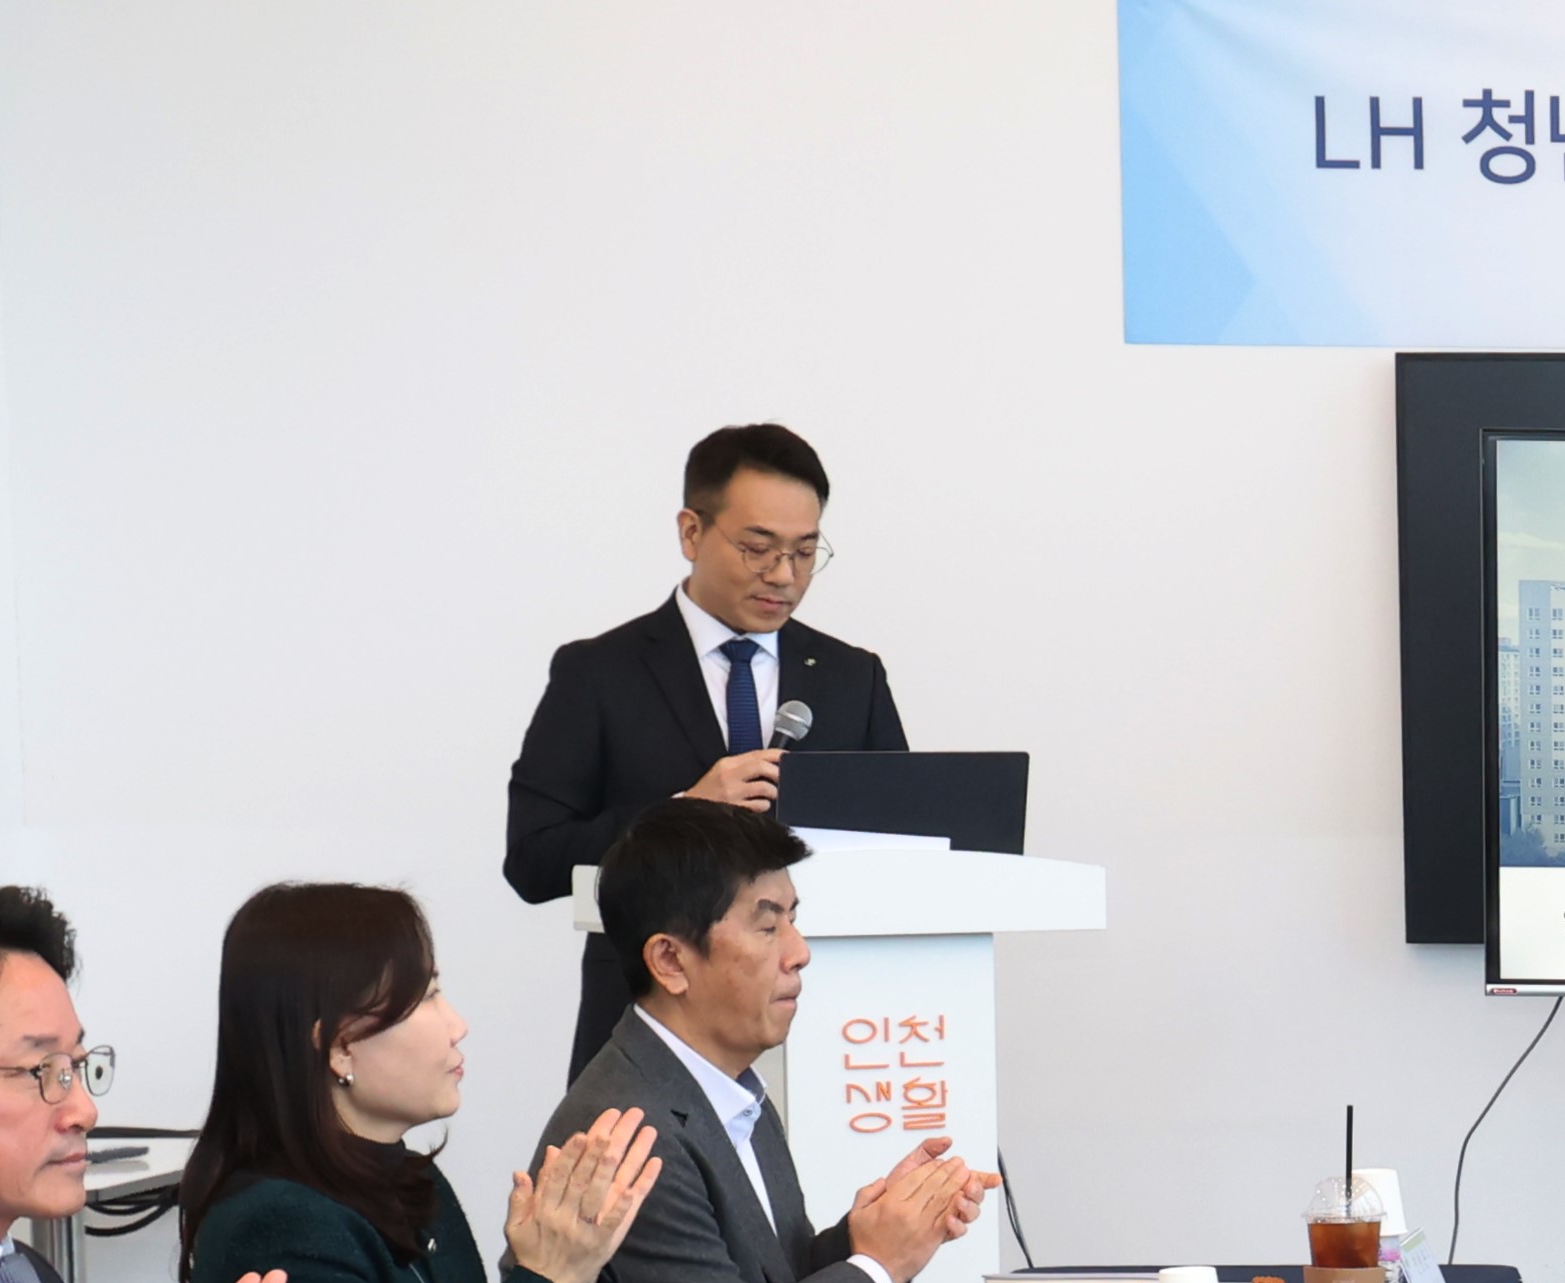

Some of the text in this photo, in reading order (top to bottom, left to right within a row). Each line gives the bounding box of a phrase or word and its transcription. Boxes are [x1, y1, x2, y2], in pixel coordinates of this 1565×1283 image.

[1312, 95, 1425, 172] LH
[841, 1013, 946, 1071] 인천
[845, 1076, 951, 1134] 생활
